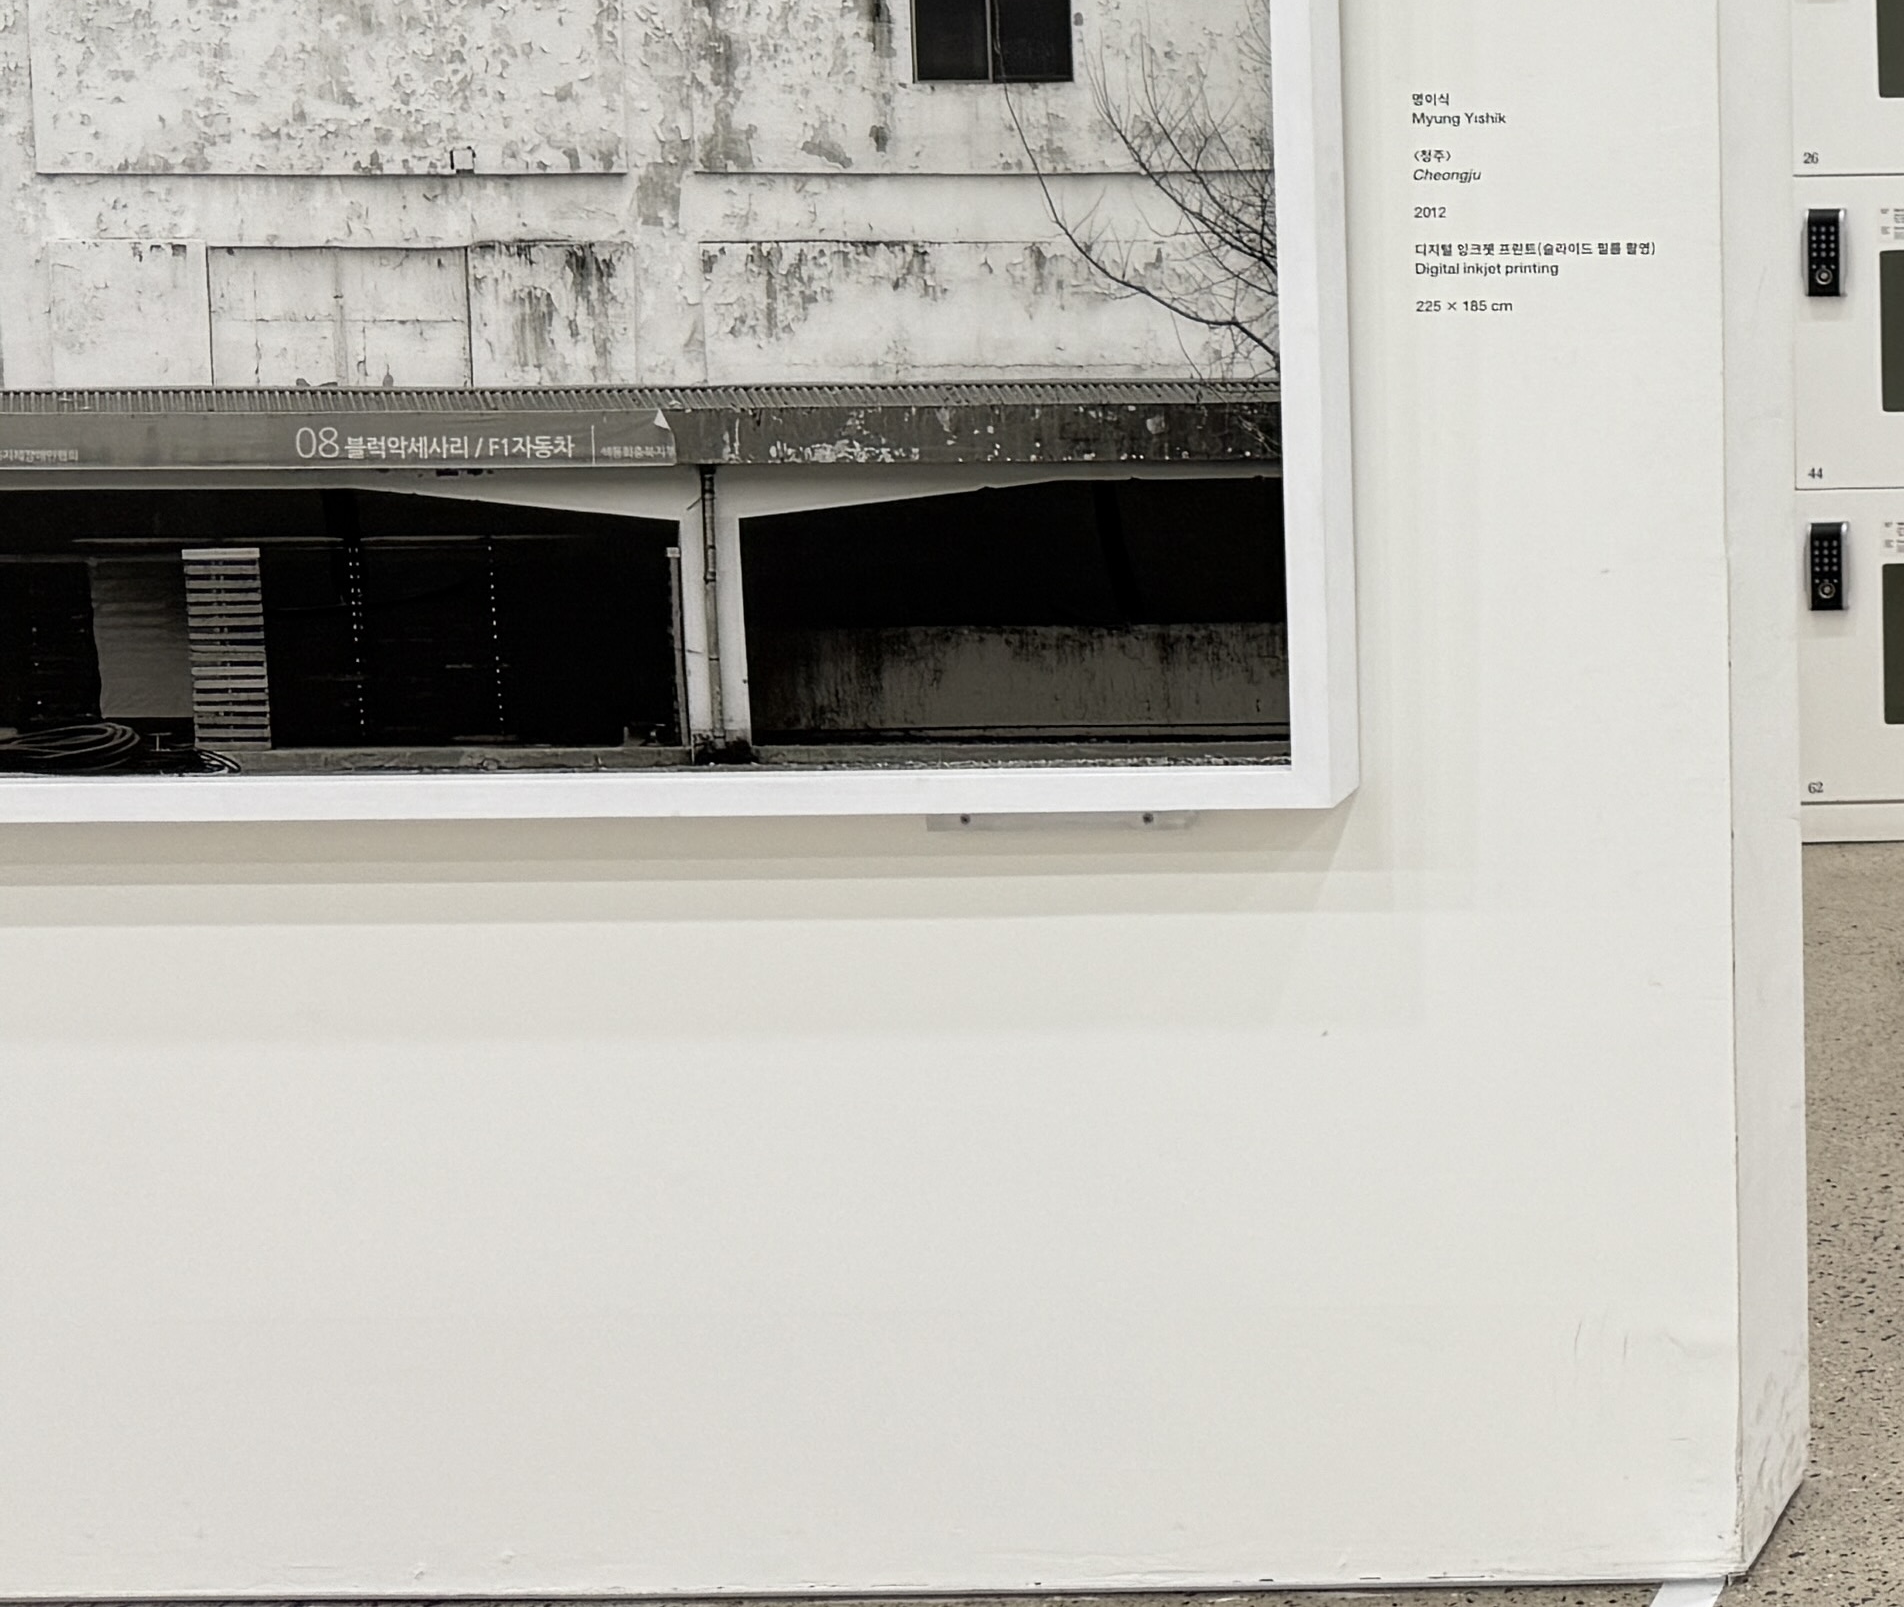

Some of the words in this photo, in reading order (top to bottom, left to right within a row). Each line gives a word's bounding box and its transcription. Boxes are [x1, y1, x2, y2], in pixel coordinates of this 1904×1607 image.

[1411, 92, 1450, 107] 명이식
[1411, 112, 1461, 128] Myung
[1464, 112, 1507, 124] Yishik
[1803, 151, 1819, 165] 26
[1412, 168, 1482, 184] Cheongju
[1413, 206, 1447, 219] 2012
[1415, 243, 1453, 257] 디지털
[1457, 242, 1495, 257] 잉크젯
[1415, 262, 1460, 278] Digital
[1463, 262, 1502, 277] inkjet
[1504, 263, 1559, 277] printing
[1415, 300, 1442, 313] 225
[1462, 299, 1488, 312] 185
[1491, 302, 1513, 312] cm
[295, 426, 340, 458] 08
[344, 435, 469, 459] 블럭악세사리
[489, 435, 575, 459] F1자동차
[1807, 467, 1823, 479] 44
[1807, 781, 1824, 794] 62
